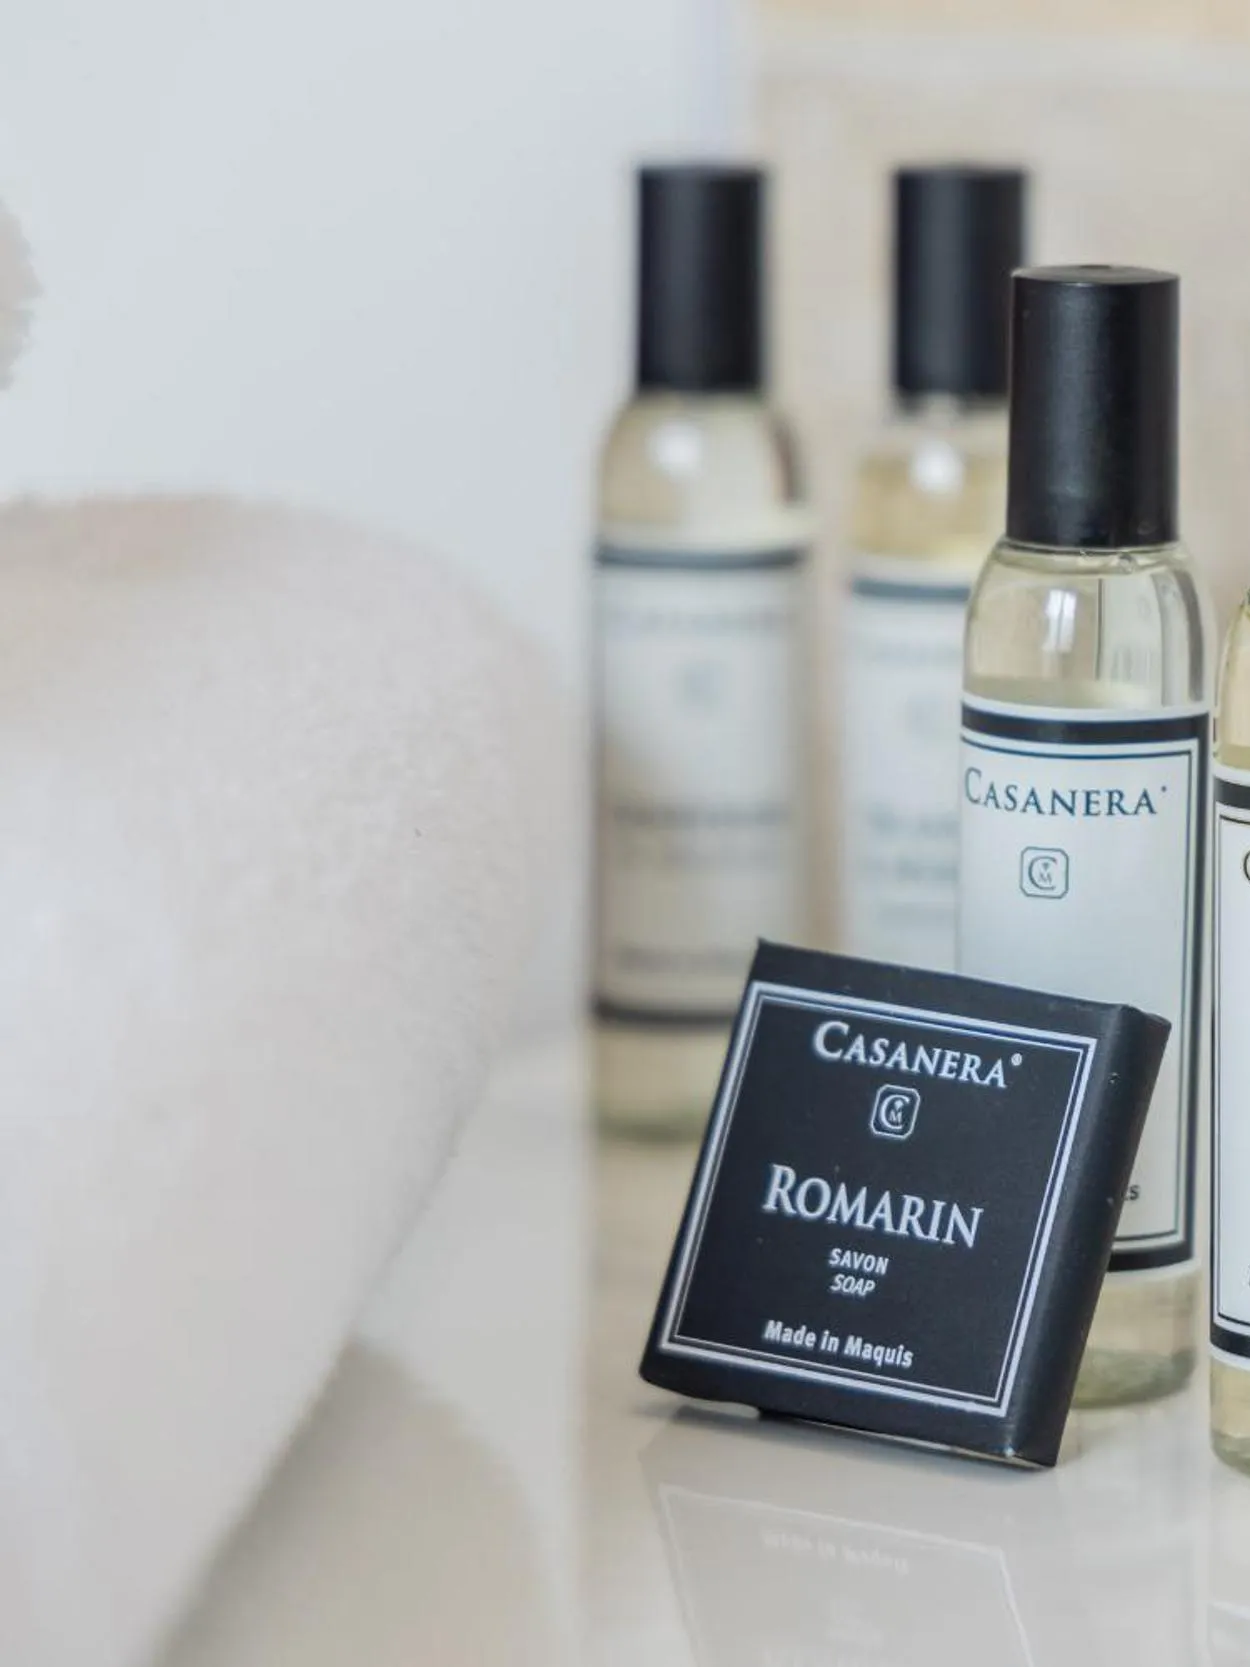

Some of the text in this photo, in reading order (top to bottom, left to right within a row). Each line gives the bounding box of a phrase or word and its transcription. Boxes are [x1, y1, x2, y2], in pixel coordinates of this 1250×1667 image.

[965, 767, 1157, 817] CASANERA
[762, 1163, 984, 1248] ROMARIN
[828, 1248, 889, 1275] SAVON
[830, 1273, 876, 1298] SOAP
[763, 1319, 914, 1368] Made in Maquis
